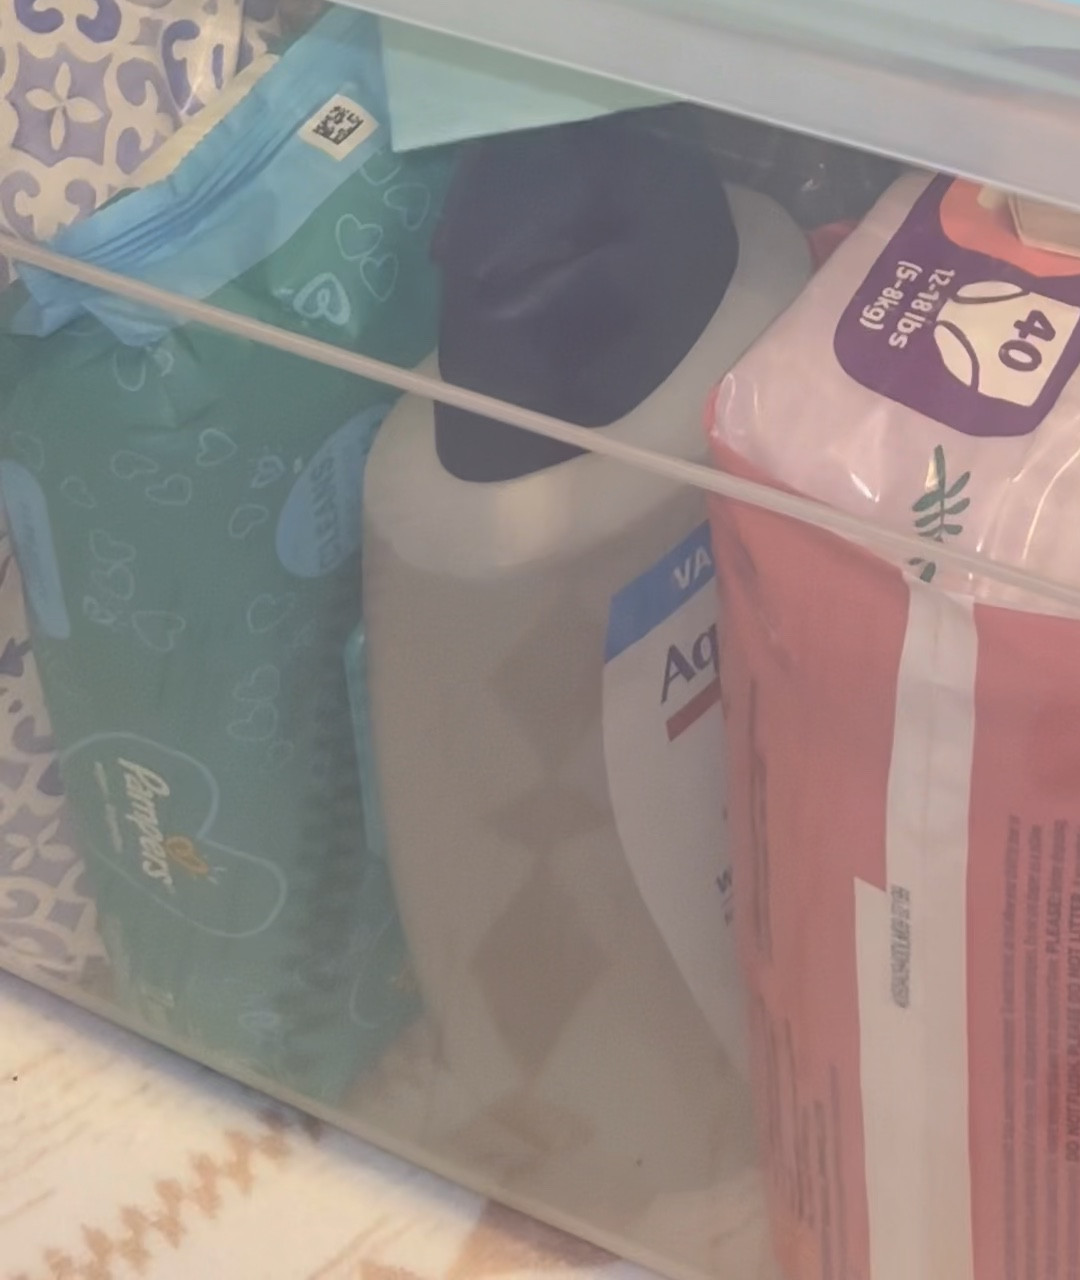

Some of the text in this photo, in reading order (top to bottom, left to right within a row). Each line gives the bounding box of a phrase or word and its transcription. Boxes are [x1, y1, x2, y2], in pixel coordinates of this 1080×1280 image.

[859, 260, 924, 331] (5-8kg)
[888, 268, 956, 350] 12-18 lbs
[997, 309, 1057, 373] 40
[315, 456, 341, 569] CLEANS
[117, 756, 173, 886] Pampers
